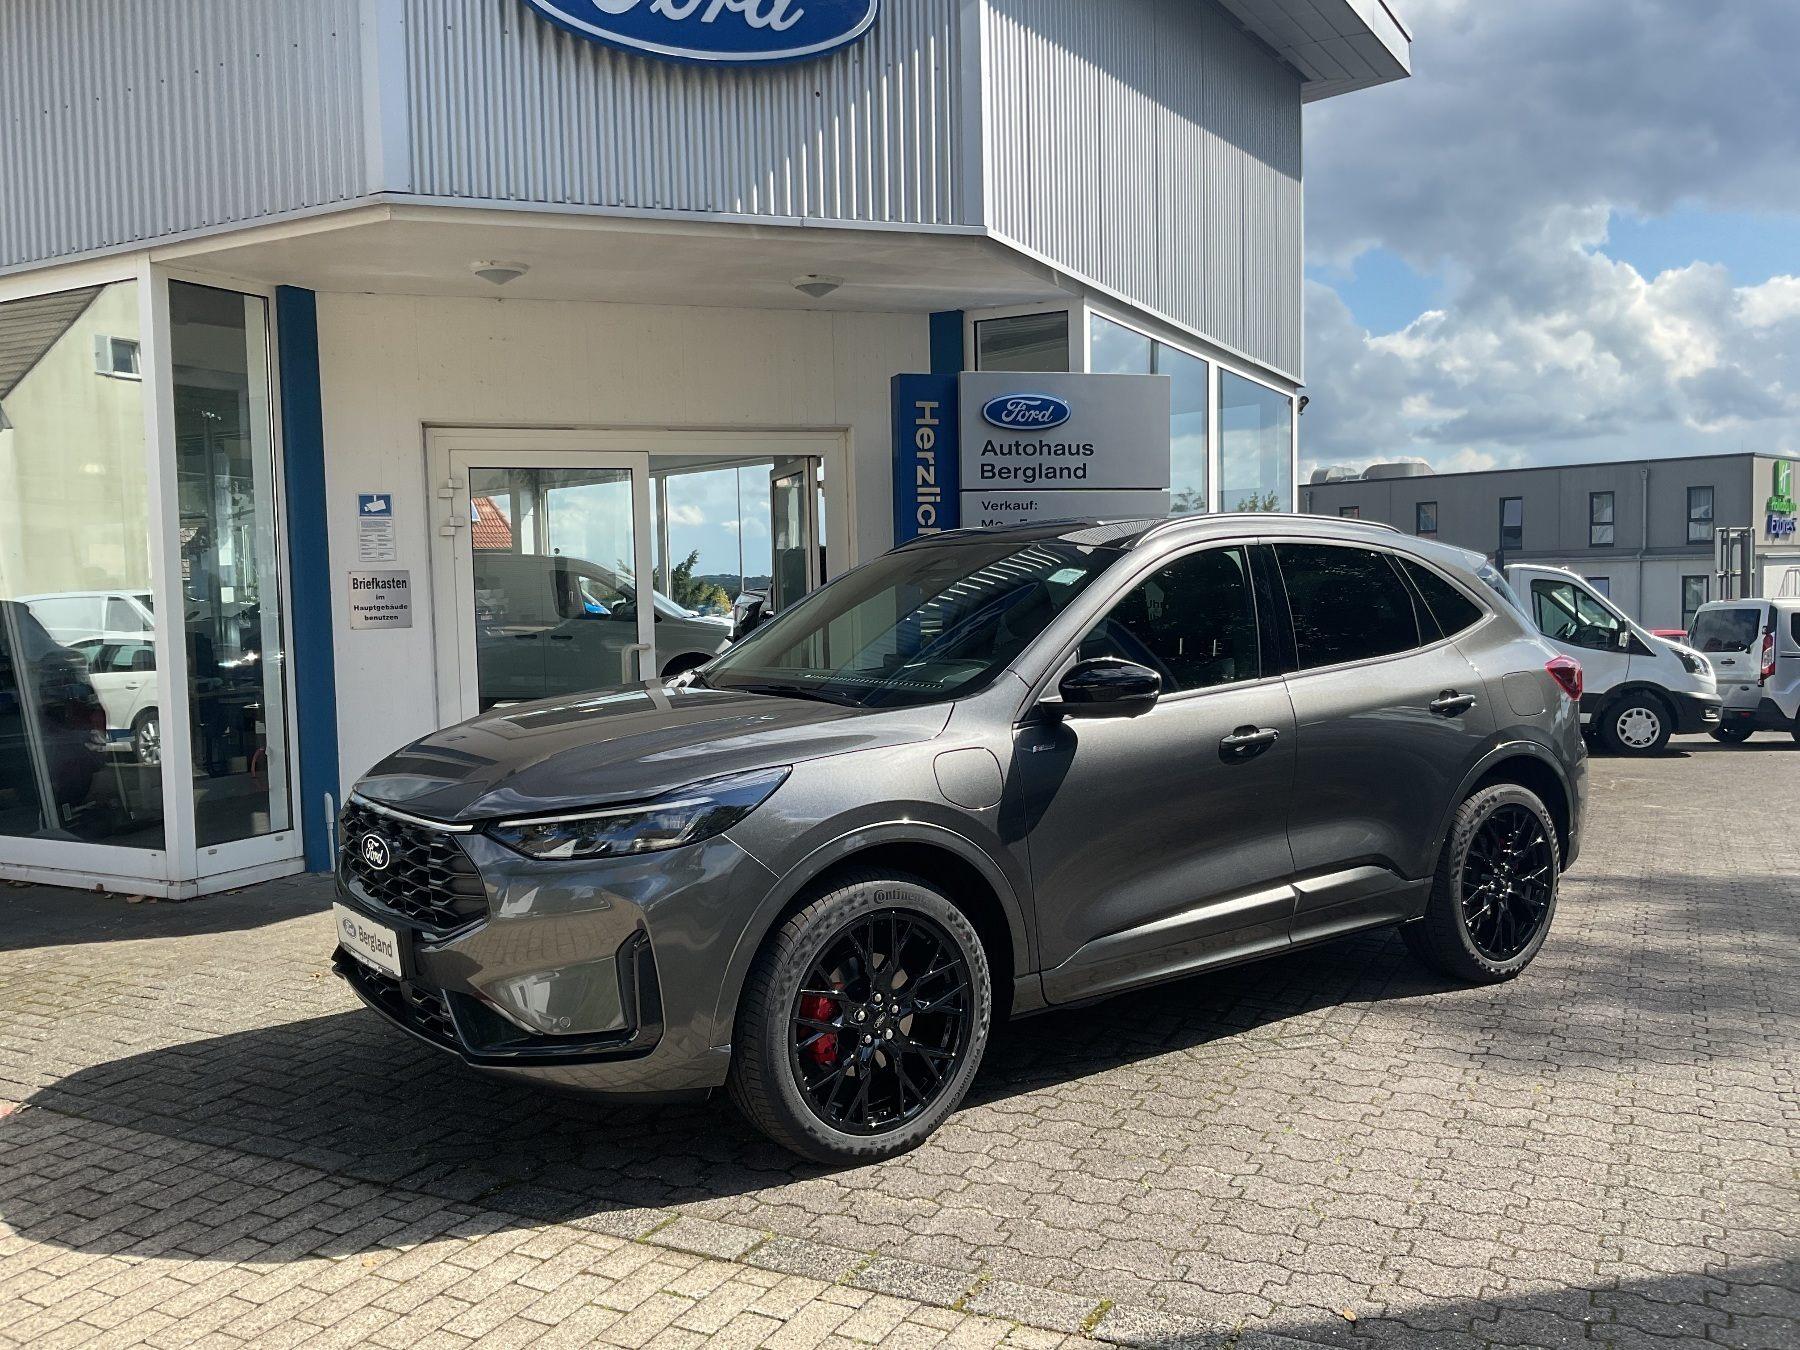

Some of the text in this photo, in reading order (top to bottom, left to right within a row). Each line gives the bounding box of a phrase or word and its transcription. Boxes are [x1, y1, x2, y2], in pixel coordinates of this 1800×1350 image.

[1001, 399, 1055, 423] Ford
[980, 440, 1095, 457] Autohaus
[980, 463, 1087, 483] Bergland
[981, 500, 1038, 511] Verkauf:
[352, 577, 407, 590] Briefkasten
[353, 604, 408, 612] Hauptgebäude
[365, 838, 384, 865] Ford
[358, 924, 394, 958] Bergland
